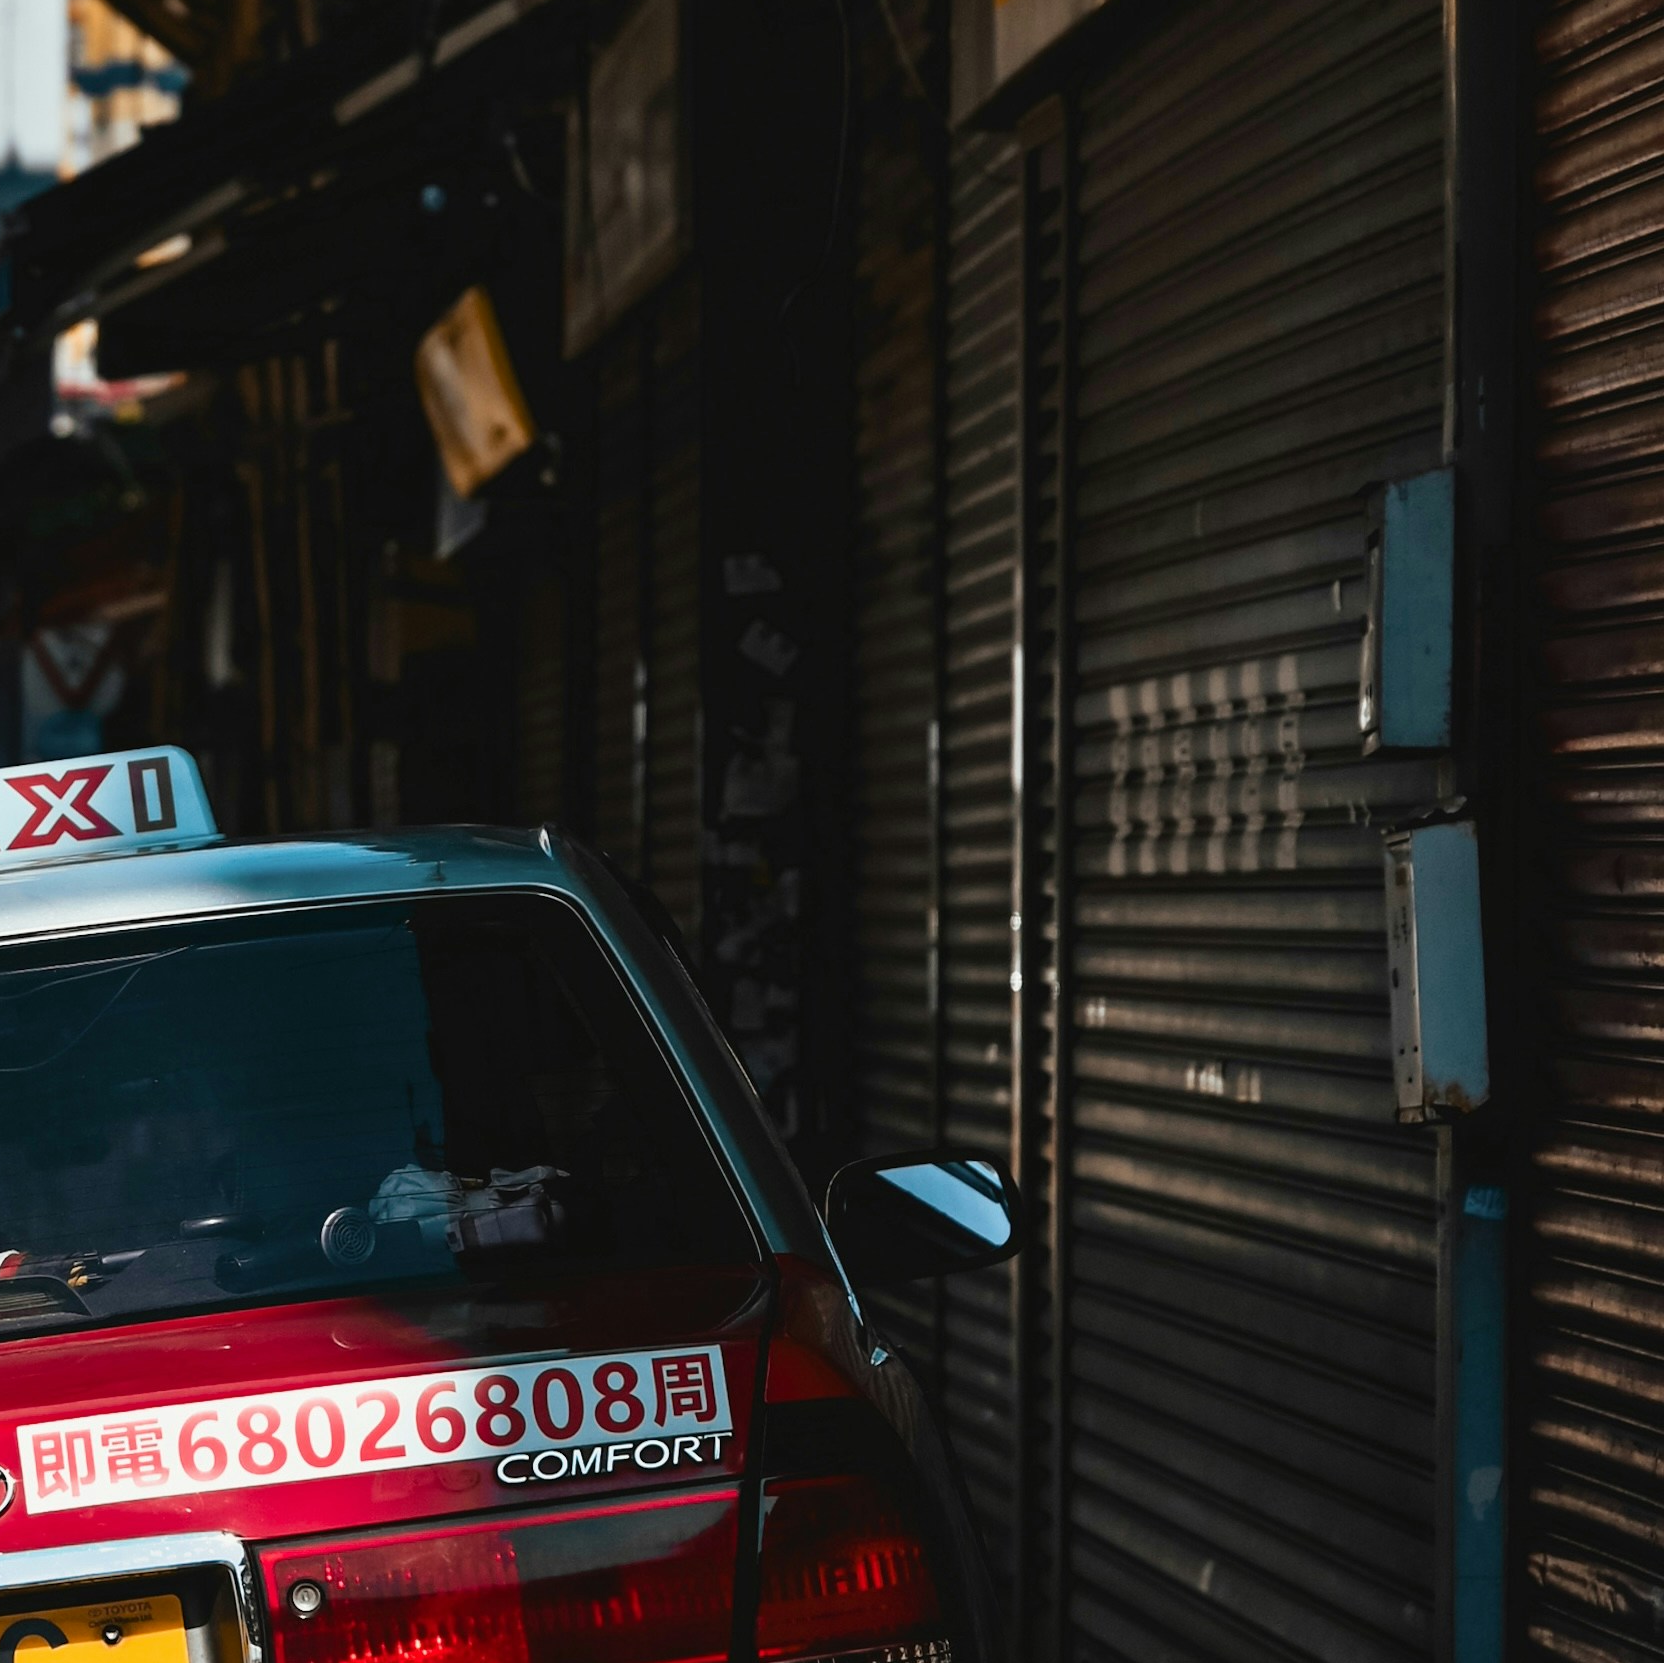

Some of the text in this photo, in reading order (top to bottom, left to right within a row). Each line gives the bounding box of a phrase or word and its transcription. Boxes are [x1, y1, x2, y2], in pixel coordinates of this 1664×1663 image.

[32, 1351, 719, 1501] 即電68026808周
[496, 1431, 733, 1485] COMFORT
[103, 1600, 153, 1615] TOYOTA
